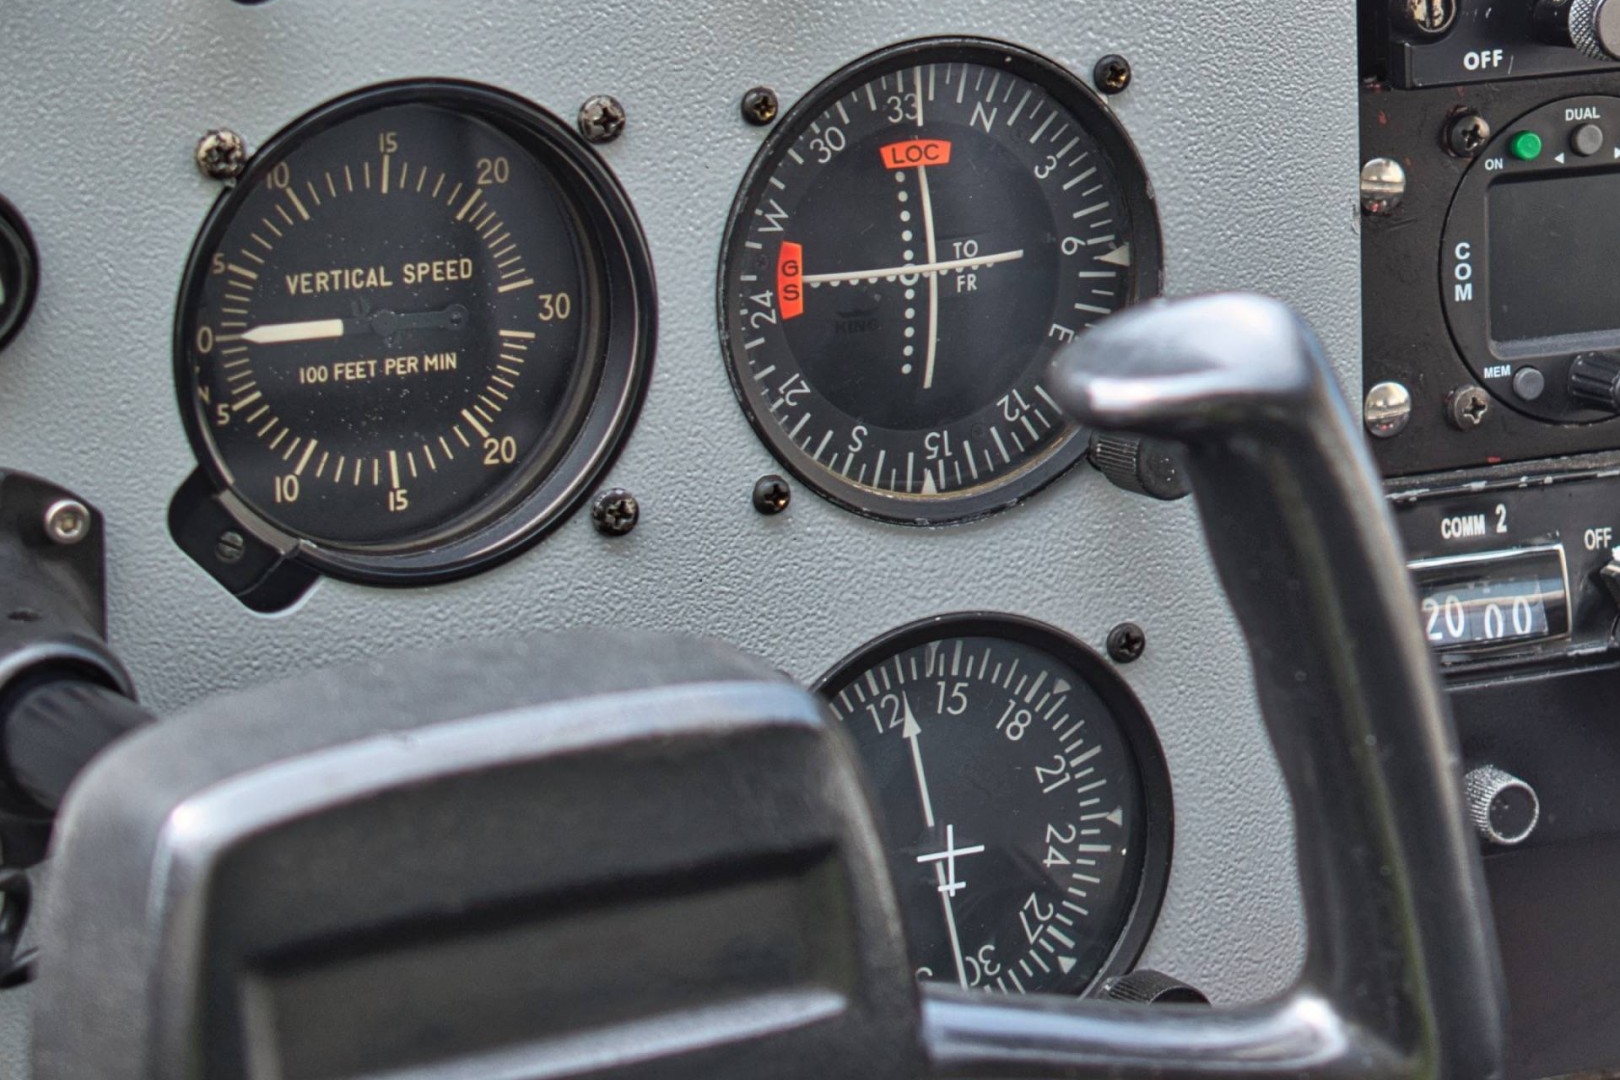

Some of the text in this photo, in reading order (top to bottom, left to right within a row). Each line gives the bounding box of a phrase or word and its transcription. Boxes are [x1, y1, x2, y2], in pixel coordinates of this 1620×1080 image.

[1463, 48, 1504, 71] OFF
[887, 93, 917, 124] 33
[970, 102, 998, 132] N
[1565, 107, 1600, 121] DUAL
[379, 132, 397, 153] 15
[810, 126, 846, 164] 30
[892, 144, 940, 164] LOC
[477, 158, 509, 185] 20
[1485, 159, 1503, 170] ON
[953, 241, 978, 258] TO
[286, 258, 473, 294] VERTICAL SPEED
[957, 276, 977, 292] FR
[1455, 243, 1473, 301] COM
[539, 293, 570, 321] 30
[751, 290, 776, 325] 24
[197, 327, 213, 353] 0
[300, 352, 457, 384] 100 FEET PER MIN
[1484, 365, 1511, 379] MEM
[217, 404, 230, 424] 5
[483, 437, 517, 464] 20
[275, 475, 299, 502] 10
[390, 490, 409, 511] 15
[1441, 504, 1508, 539] COMM 2
[1584, 527, 1612, 550] OFF
[937, 682, 968, 715] 15
[866, 693, 904, 733] 12
[996, 699, 1033, 741] 18
[1035, 755, 1072, 794] 21
[1043, 824, 1076, 868] 24
